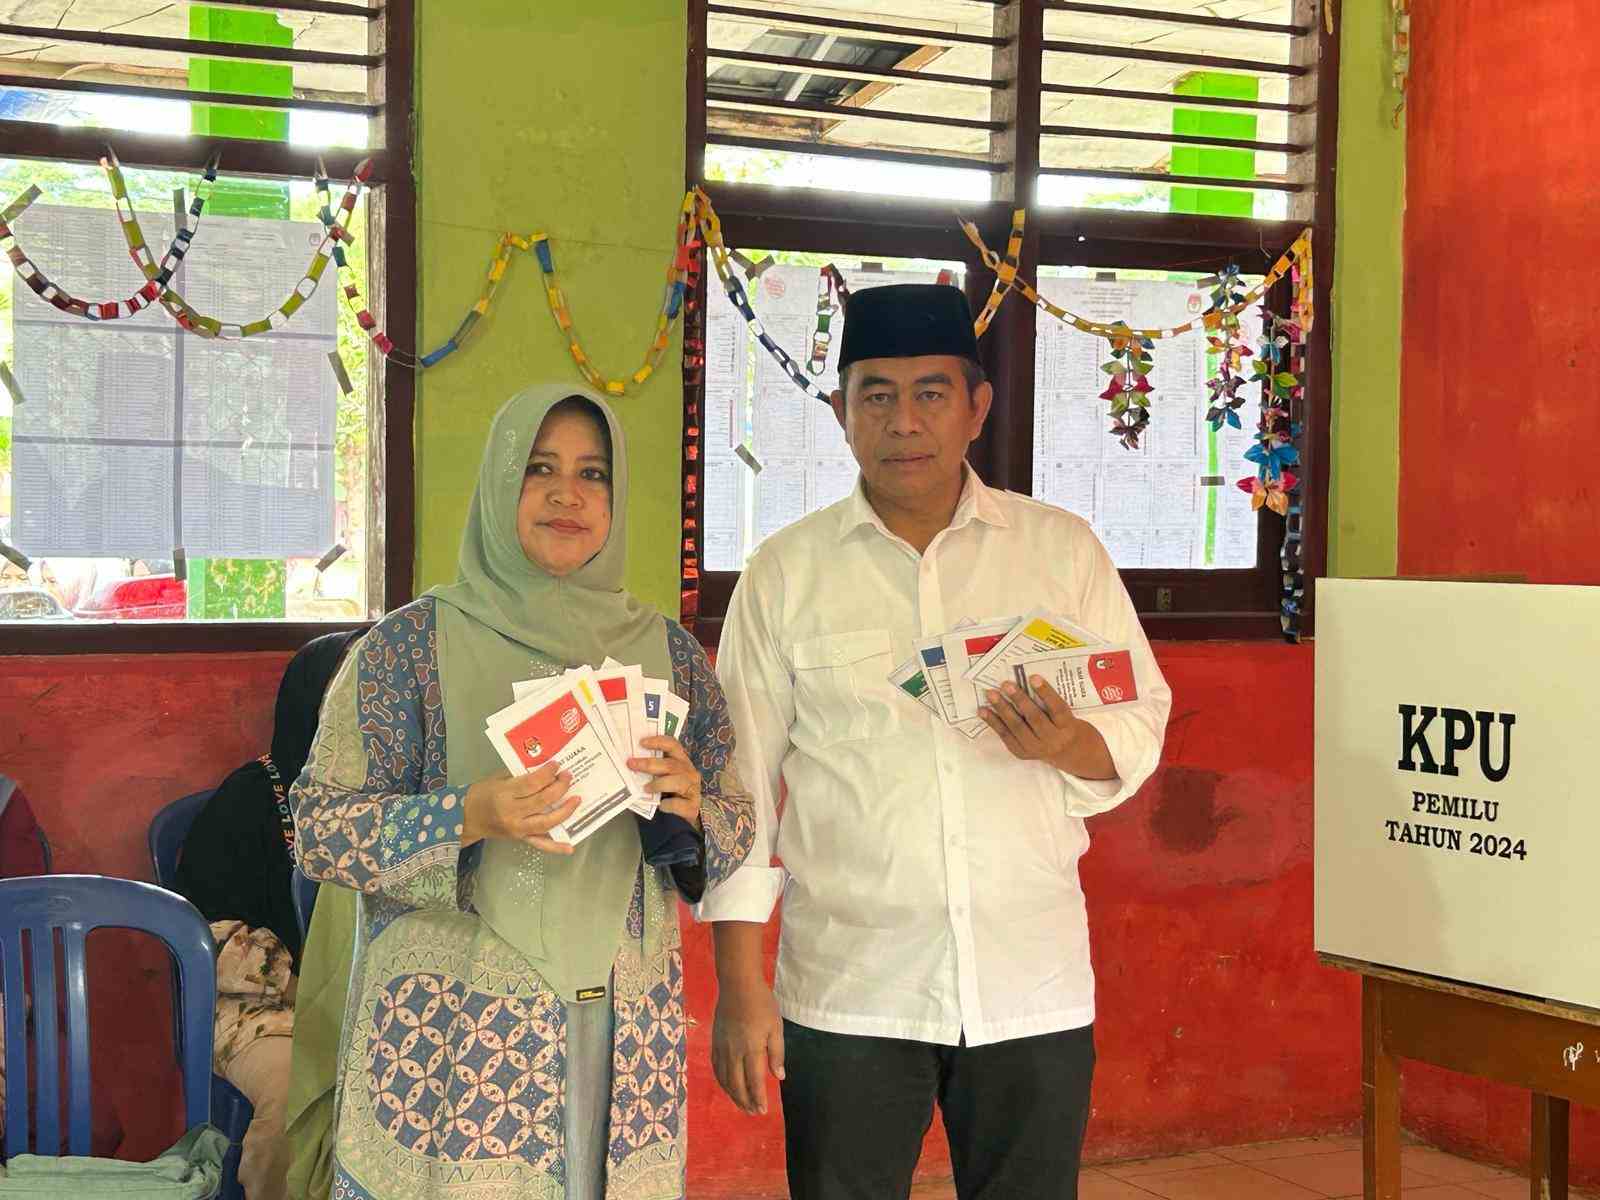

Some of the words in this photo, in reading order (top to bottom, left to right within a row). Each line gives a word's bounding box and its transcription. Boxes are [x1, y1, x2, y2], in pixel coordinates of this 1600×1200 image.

[647, 700, 655, 711] 5
[1398, 704, 1516, 782] KPU
[274, 784, 292, 823] LOVE
[1412, 791, 1499, 822] PEMILU
[1385, 820, 1462, 851] TAHUN
[1470, 833, 1527, 861] 2024
